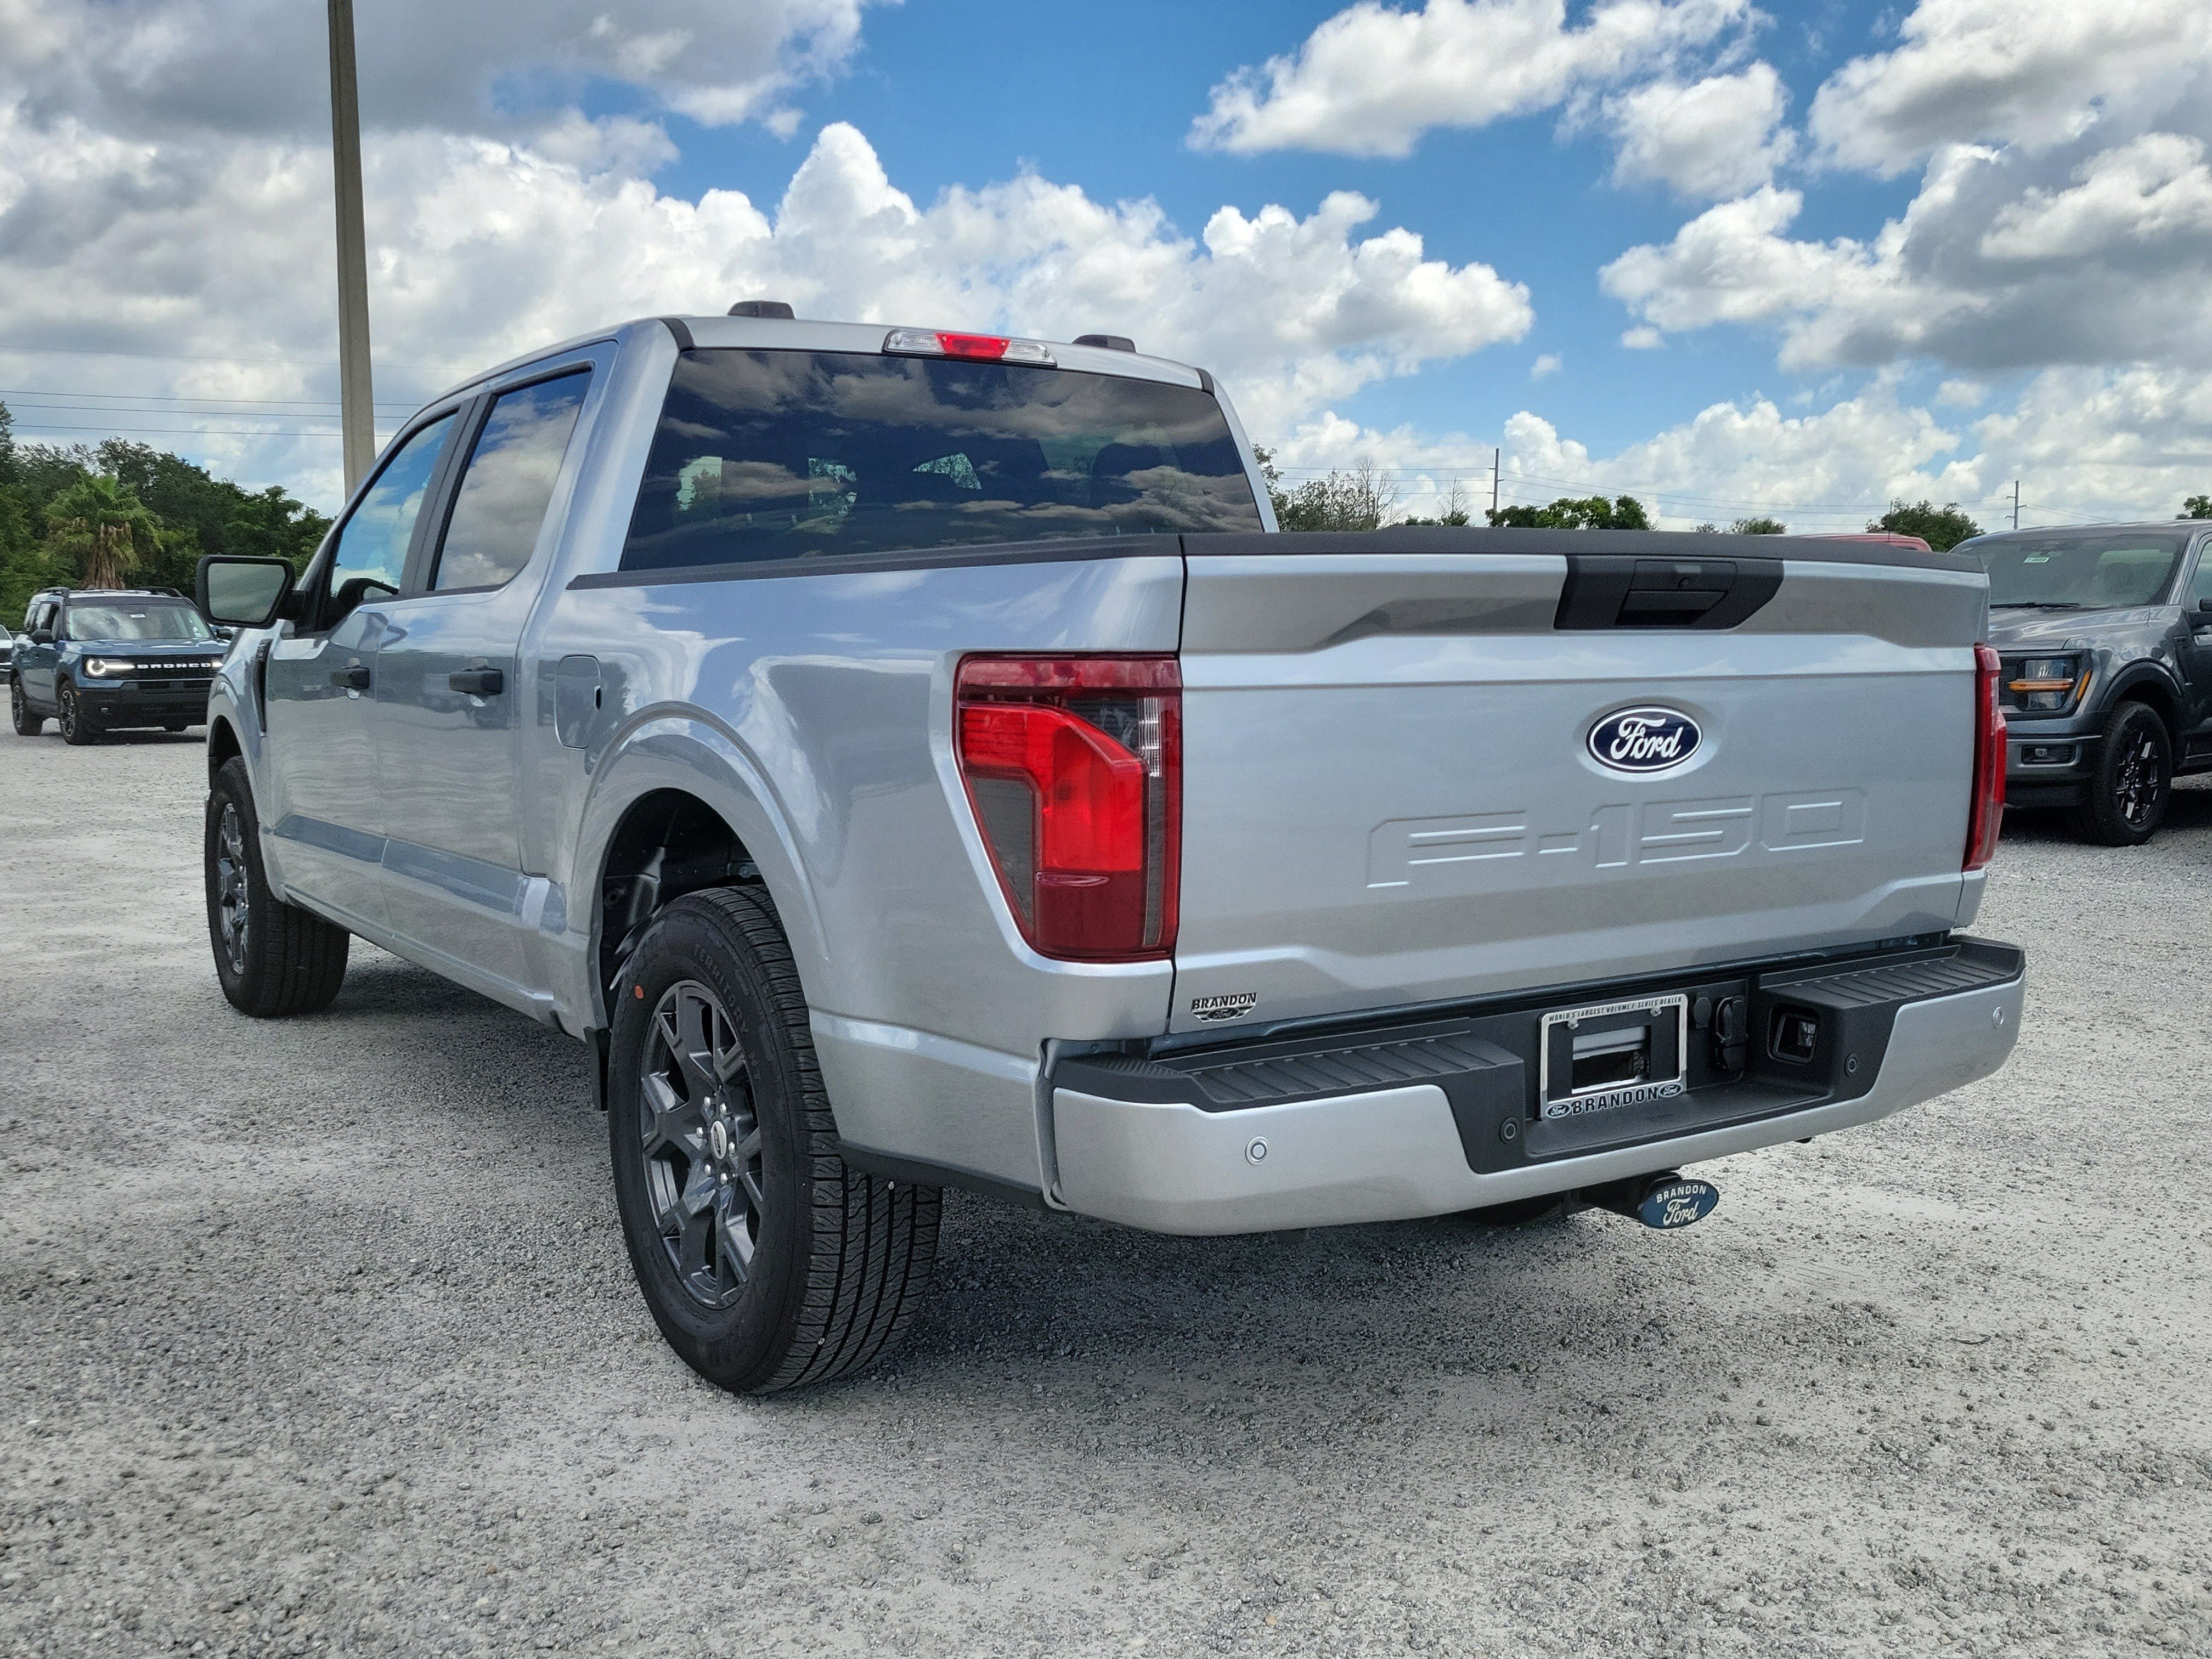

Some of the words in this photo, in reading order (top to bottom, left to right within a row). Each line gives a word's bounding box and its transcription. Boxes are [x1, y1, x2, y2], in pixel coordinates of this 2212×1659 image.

[1609, 716, 1683, 759] Ford
[1366, 786, 1865, 888] F-150
[1191, 992, 1257, 1010] BRANDON
[1578, 1008, 1604, 1017] LARGEST
[1606, 1005, 1630, 1013] VOLUME
[1660, 996, 1681, 1005] DEALER
[1572, 1086, 1658, 1114] BRANDON
[1656, 1185, 1706, 1203] BRANDON
[1662, 1197, 1700, 1226] Ford
